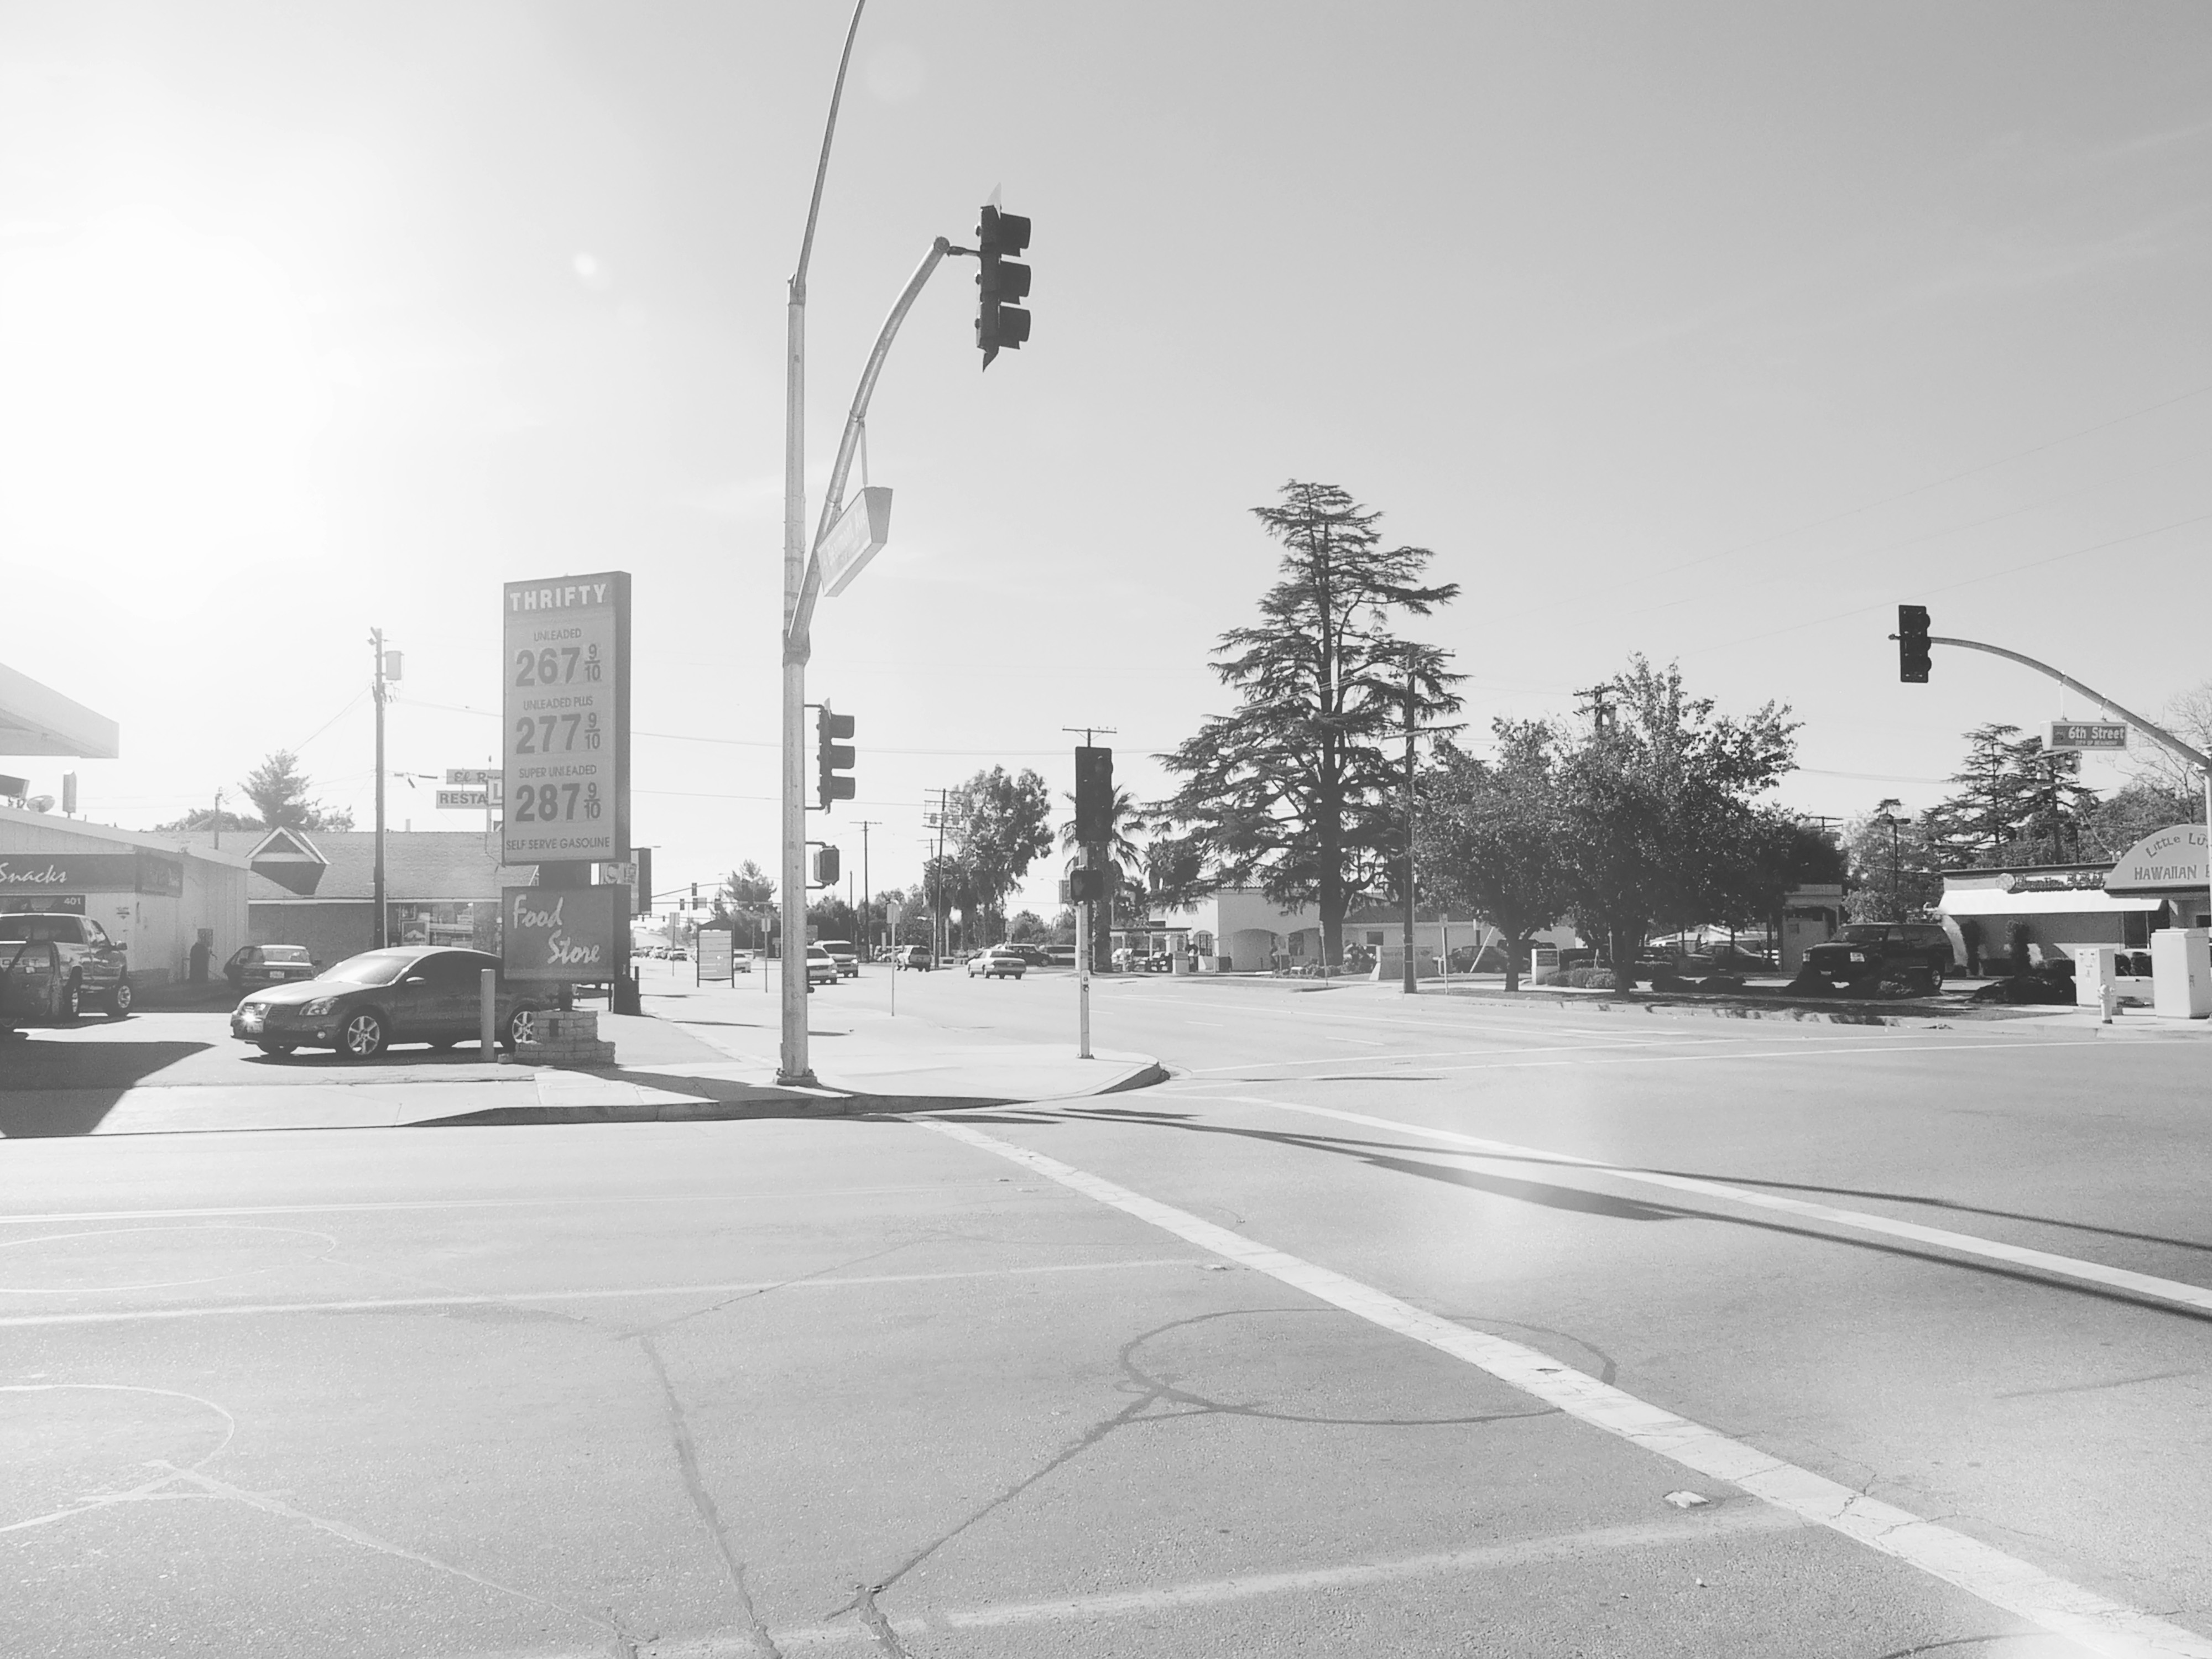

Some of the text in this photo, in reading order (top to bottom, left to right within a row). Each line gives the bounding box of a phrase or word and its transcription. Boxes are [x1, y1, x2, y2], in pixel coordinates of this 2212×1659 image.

[510, 583, 607, 611] THRIFTY
[534, 628, 581, 641] UNLEADED
[515, 647, 581, 687] 267
[523, 696, 593, 711] UNLEADED PLUS
[516, 713, 581, 754] 277
[2069, 727, 2124, 739] 6th Street
[519, 765, 597, 779] SUPER UNLEADED
[440, 793, 487, 804] RESTA
[515, 782, 581, 822] 287
[507, 837, 610, 851] SELF SERVE GASOLINE
[0, 862, 67, 883] Snacks
[2135, 865, 2197, 880] HAWAIIAN
[513, 894, 564, 928] Food
[547, 929, 600, 964] Store
